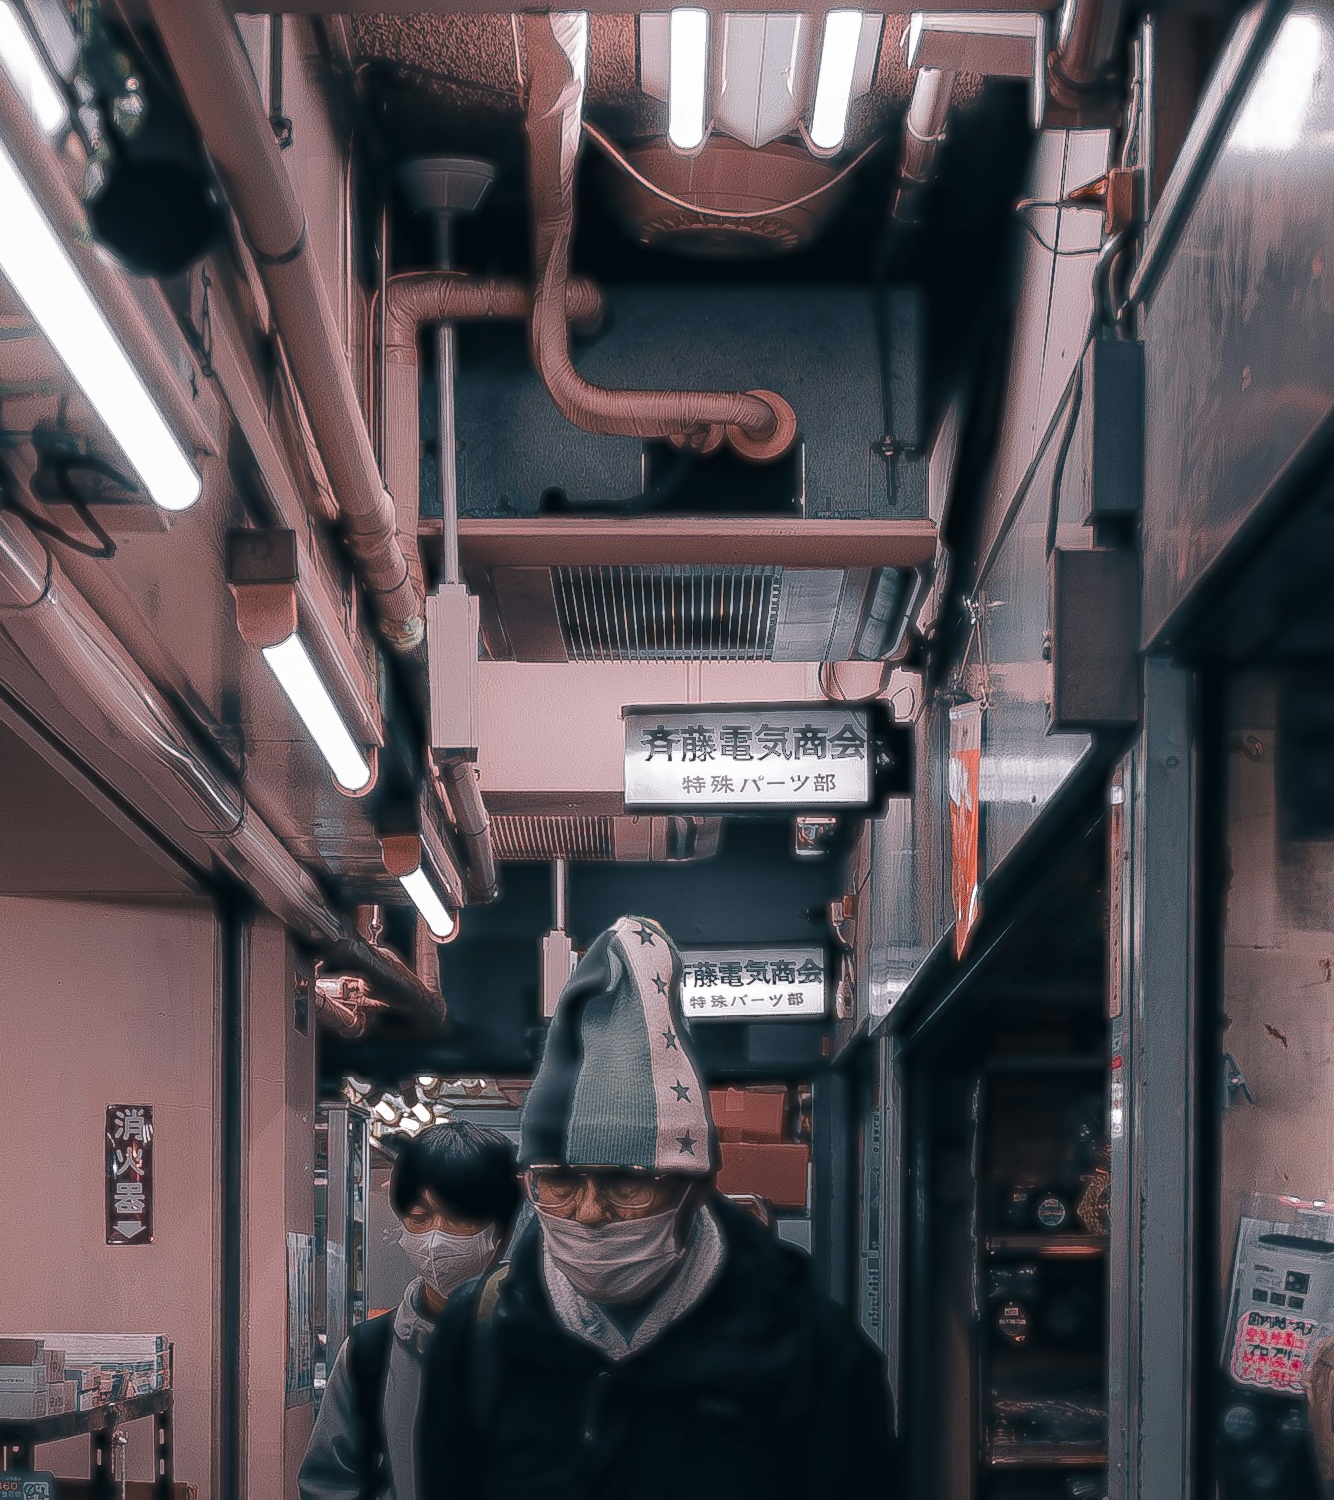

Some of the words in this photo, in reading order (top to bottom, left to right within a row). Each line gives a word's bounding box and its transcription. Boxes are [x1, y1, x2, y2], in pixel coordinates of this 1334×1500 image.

[639, 723, 867, 762] 斉藤電気商会
[682, 773, 837, 794] 特殊パーツ部
[689, 992, 805, 1009] 特殊パーツ部
[114, 1108, 146, 1214] 消火器
